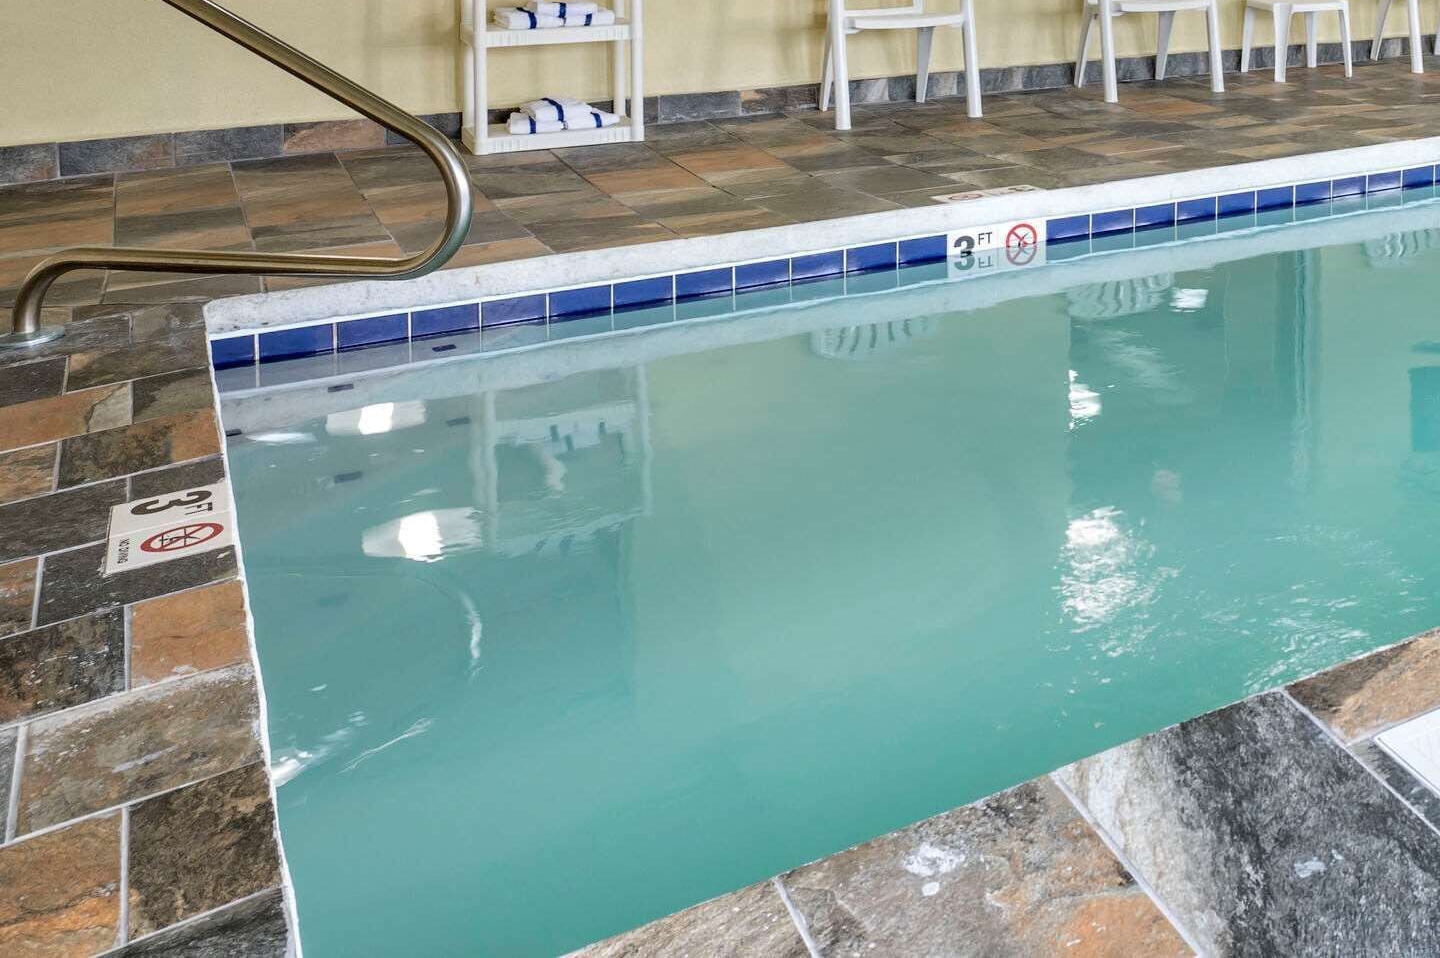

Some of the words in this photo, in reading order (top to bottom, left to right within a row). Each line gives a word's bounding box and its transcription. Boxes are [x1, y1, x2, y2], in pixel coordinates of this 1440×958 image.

[978, 231, 993, 245] FT
[130, 490, 213, 516] 3
[184, 502, 213, 516] FT
